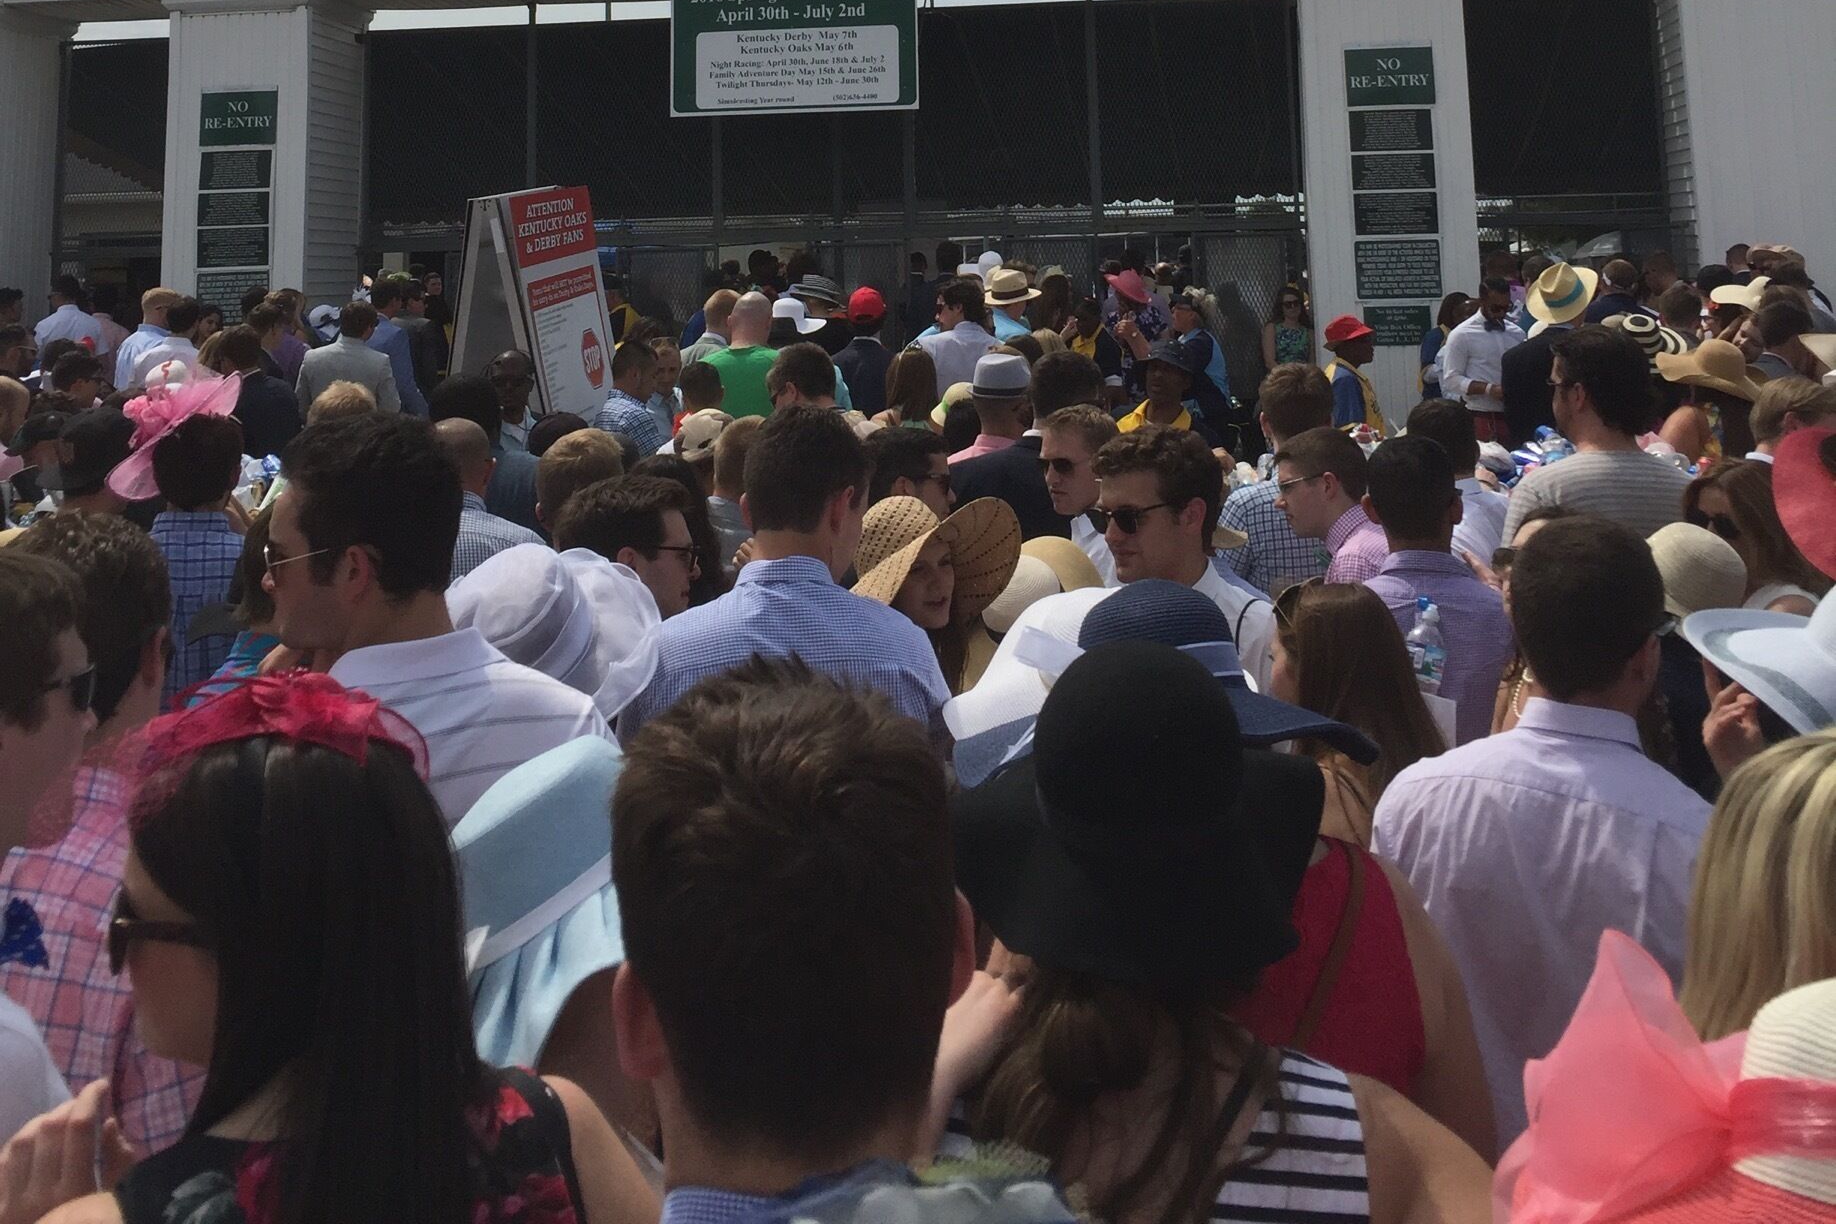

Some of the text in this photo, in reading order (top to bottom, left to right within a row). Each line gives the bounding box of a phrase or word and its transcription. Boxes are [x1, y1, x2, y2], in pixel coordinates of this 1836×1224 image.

[716, 7, 754, 25] April
[757, 5, 789, 21] 30th
[803, 4, 834, 21] July
[838, 3, 866, 17] 2nd
[736, 30, 858, 44] Kentucky Derby May 7th
[740, 42, 854, 55] Kentucky Oaks May 6th
[710, 60, 732, 70] Night
[767, 58, 787, 68] April
[810, 57, 829, 65] June
[832, 56, 849, 64] 18th
[850, 56, 858, 64] &
[861, 55, 878, 65] July
[879, 55, 885, 63] 2
[1376, 57, 1400, 71] NO
[709, 70, 735, 80] Family
[738, 69, 778, 78] Adventure
[781, 69, 796, 77] Day
[799, 68, 816, 77] May
[819, 67, 836, 75] 15th
[847, 66, 867, 74] June
[869, 65, 886, 73] 26th
[716, 80, 748, 90] Twilight
[797, 78, 814, 87] May
[816, 77, 833, 85] 12th
[841, 76, 860, 84] June
[862, 76, 879, 84] 30th
[1350, 73, 1429, 88] RE-ENTRY
[228, 101, 249, 113] NO
[204, 116, 272, 129] RE-ENTRY
[526, 198, 574, 218] ATTENTION
[518, 212, 587, 238] KENTUCKY OAKS
[526, 229, 584, 254] & DERBY FANS
[583, 344, 600, 374] STOP
